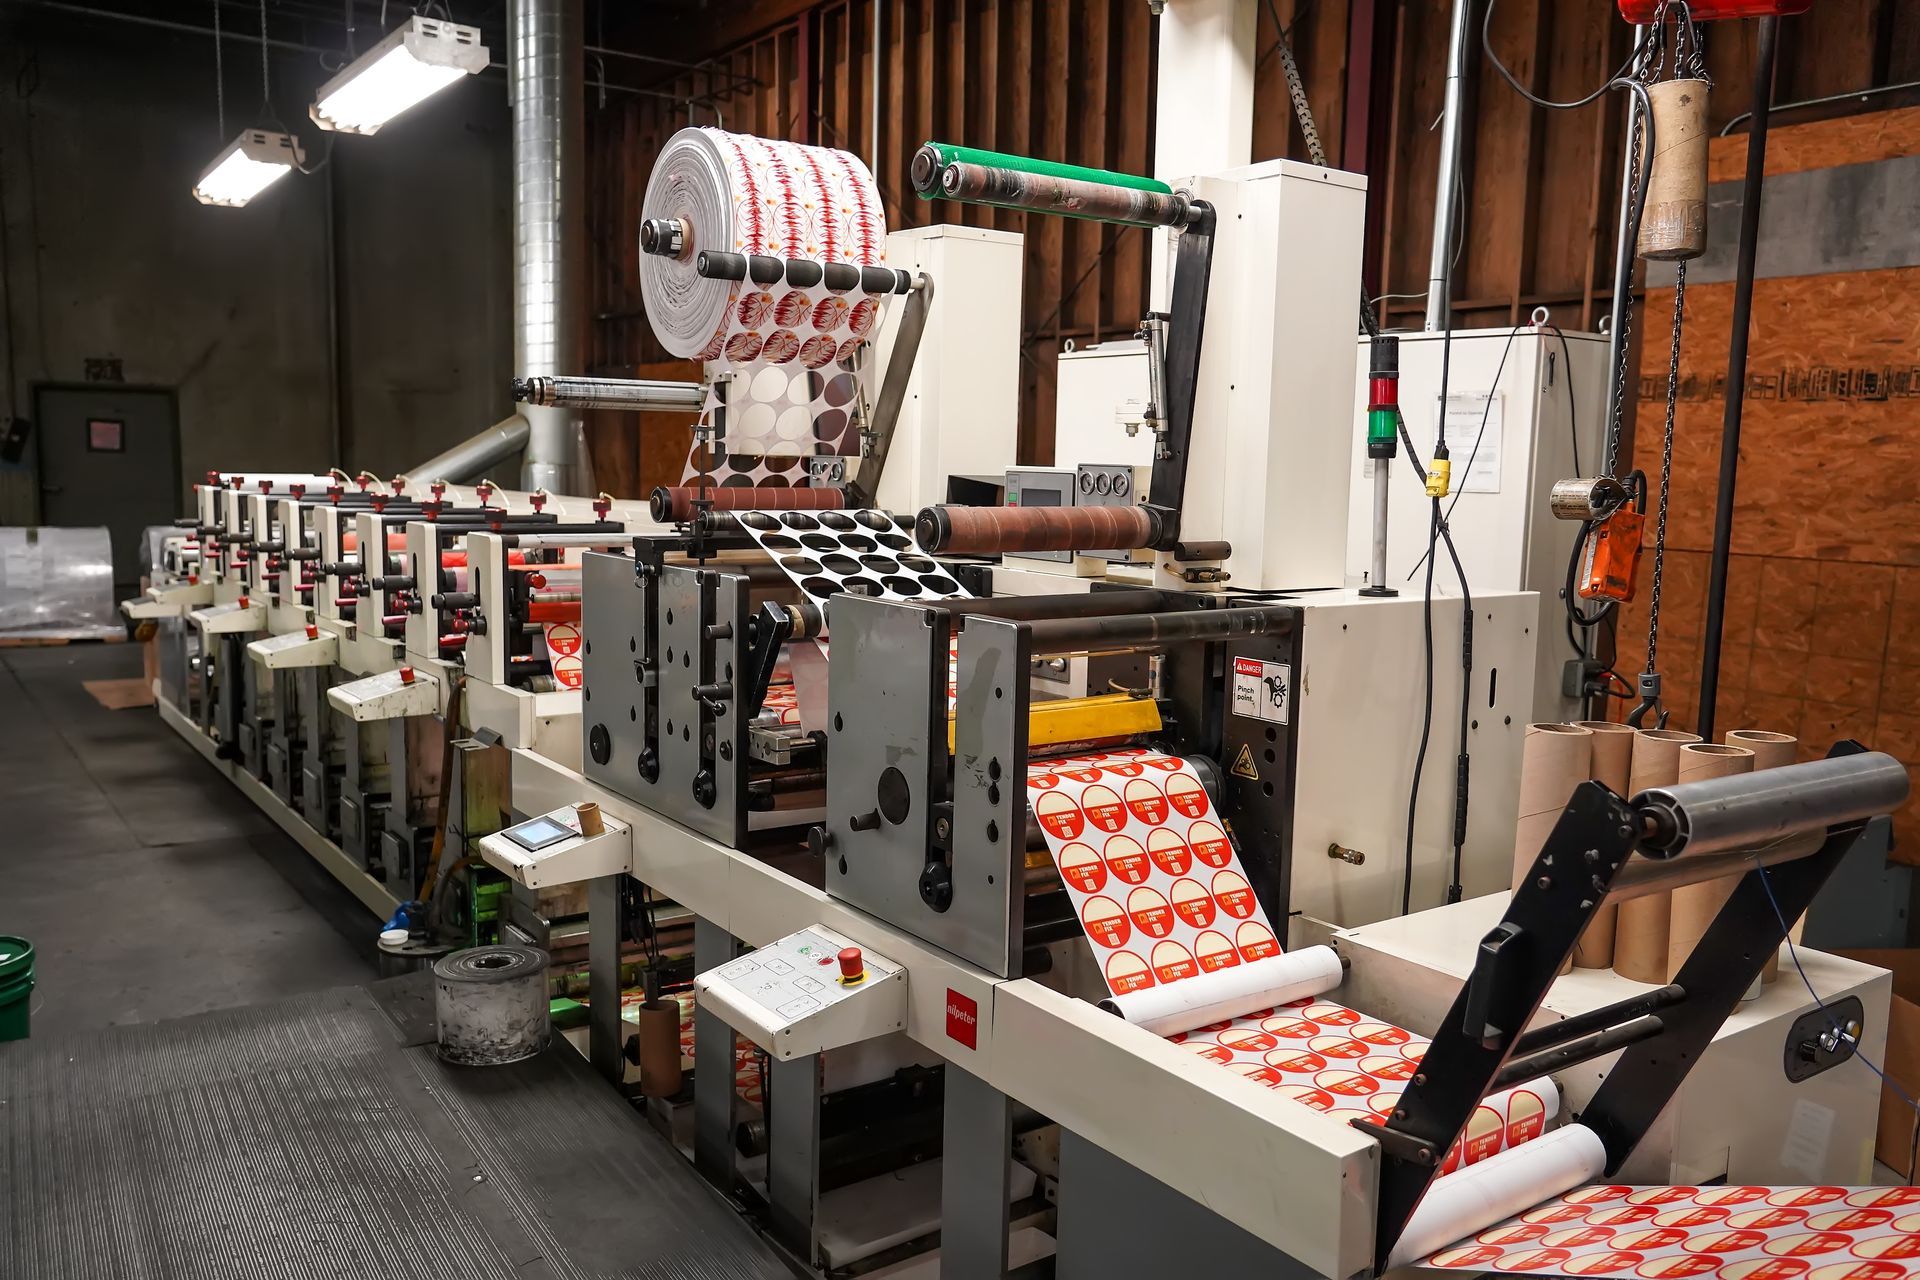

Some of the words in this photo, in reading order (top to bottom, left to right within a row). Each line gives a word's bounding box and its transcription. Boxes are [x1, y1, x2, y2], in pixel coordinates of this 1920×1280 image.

[1242, 664, 1262, 674] DANGER
[1237, 685, 1254, 694] Pinch
[1189, 900, 1207, 908] TENDER
[1146, 909, 1165, 917] TENDER
[1102, 918, 1121, 927] TENDER
[1254, 943, 1272, 951] TENDER
[1214, 953, 1231, 961] TENDER
[1171, 963, 1189, 972] TENDER
[1126, 974, 1146, 983] TENDER
[948, 1004, 975, 1024] nilpeter
